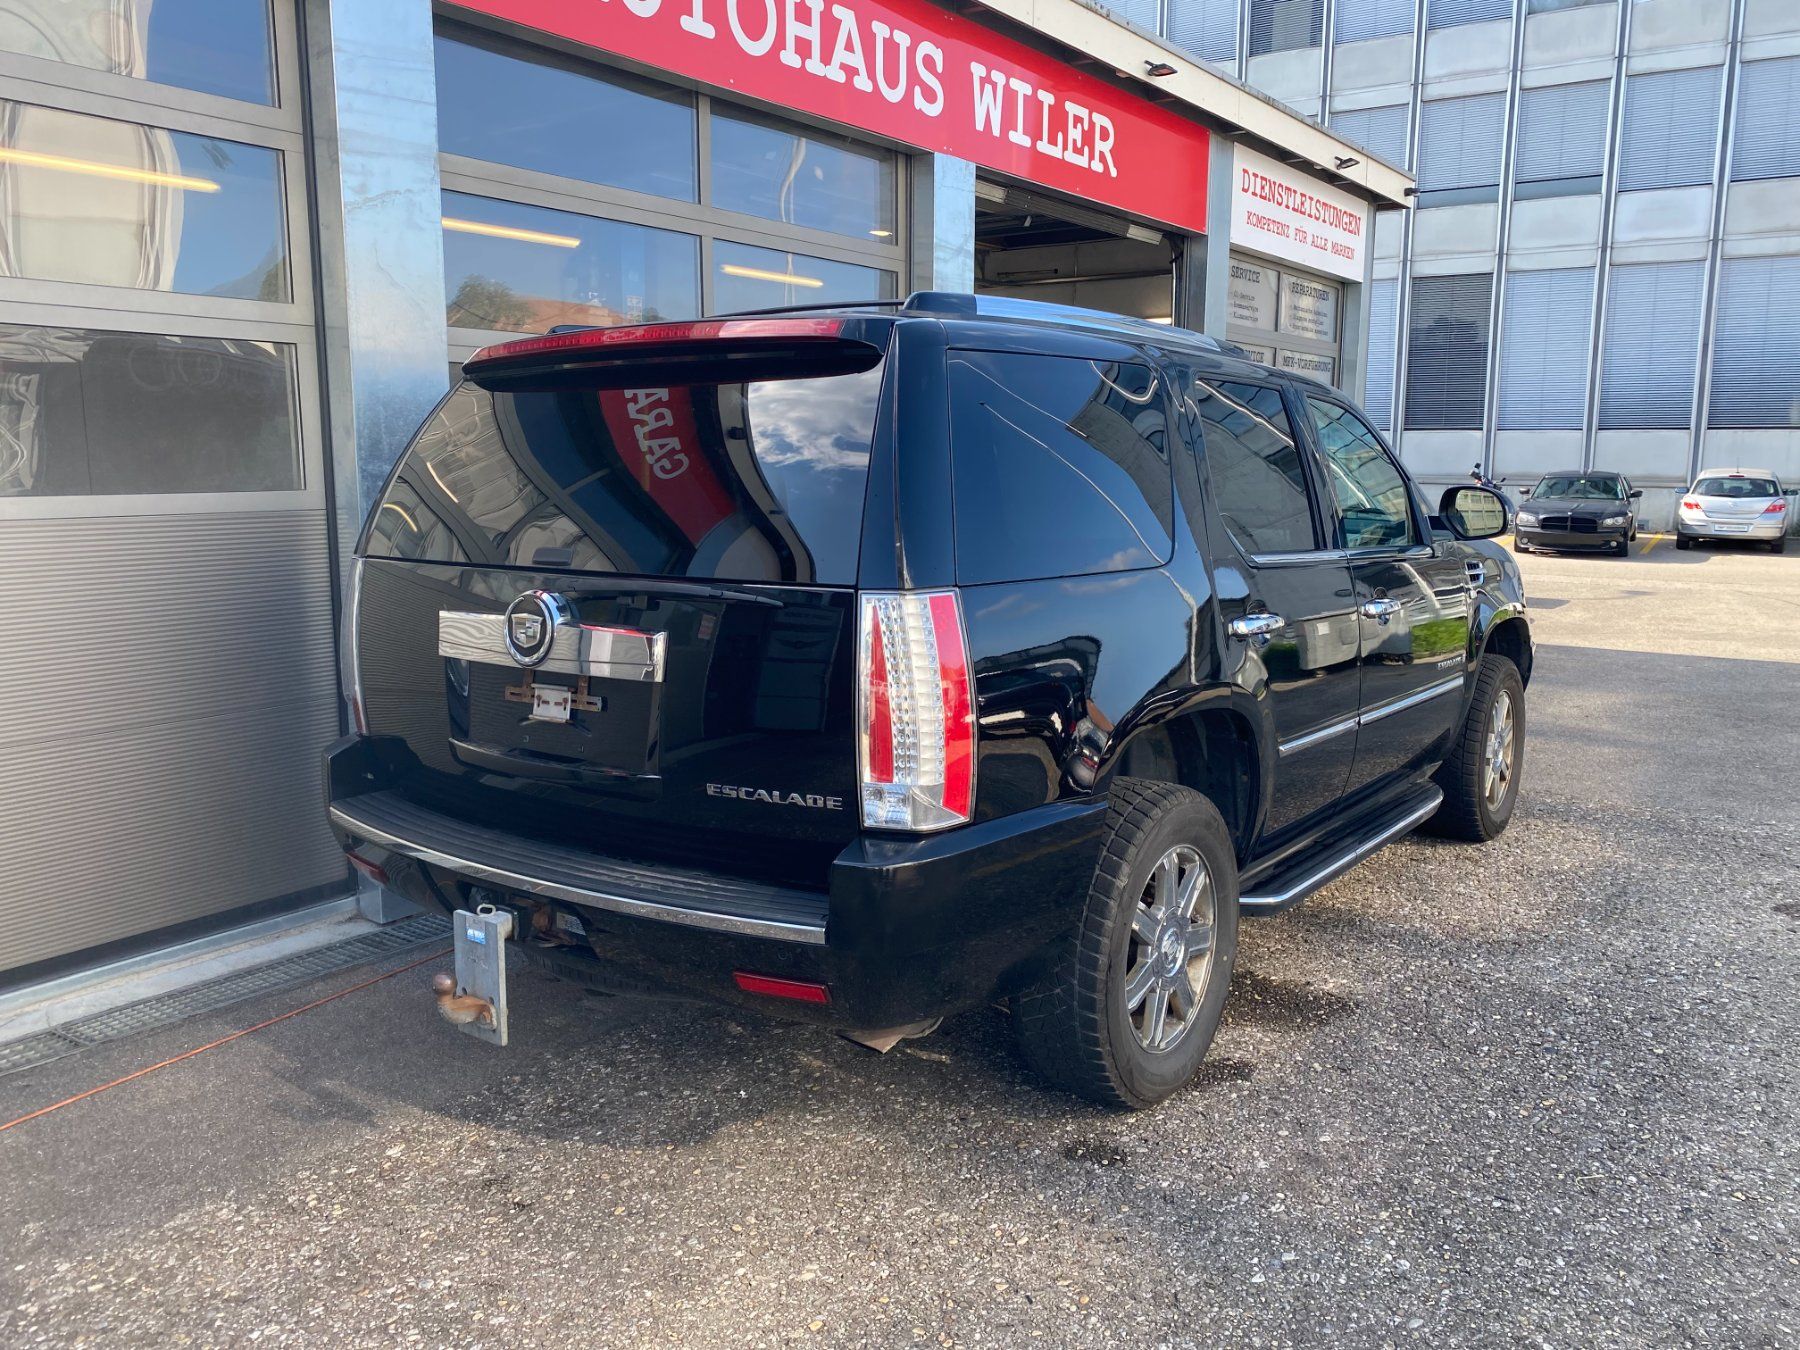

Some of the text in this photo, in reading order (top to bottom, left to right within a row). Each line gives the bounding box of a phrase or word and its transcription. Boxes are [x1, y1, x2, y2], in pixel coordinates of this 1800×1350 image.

[970, 61, 1118, 178] WILER
[1241, 167, 1362, 237] DIENSTLEISTUNGEN
[1246, 210, 1290, 239] KOMPETENZ
[1294, 225, 1308, 245] FÜR
[1310, 233, 1329, 252] ALLE
[1230, 265, 1261, 284] SERVICE
[706, 783, 843, 810] ESCALADE
